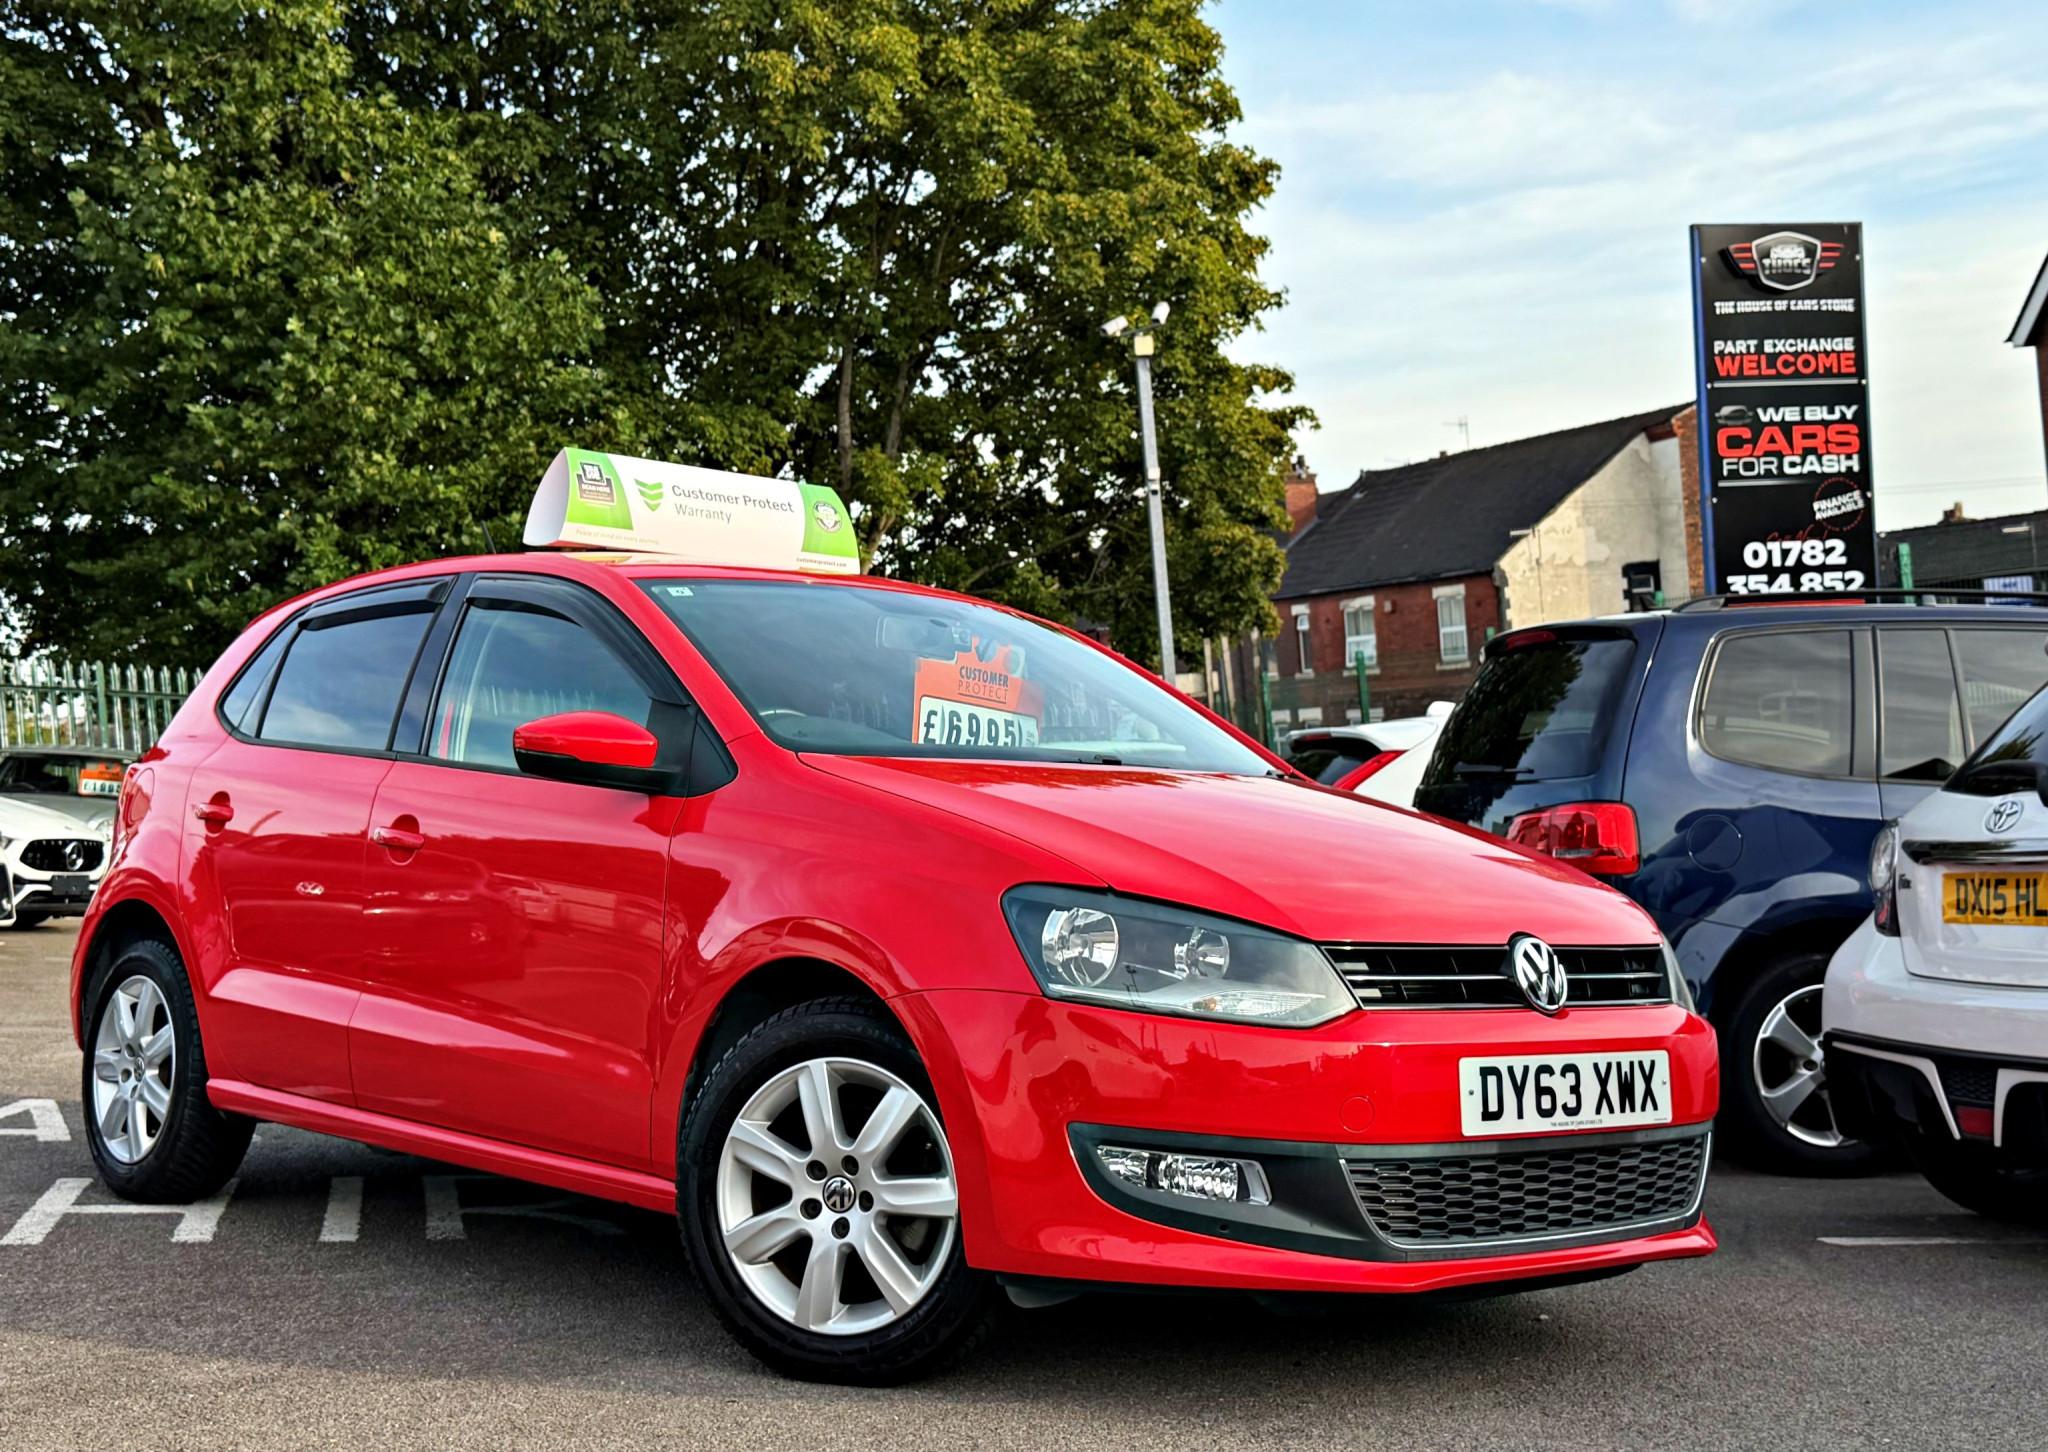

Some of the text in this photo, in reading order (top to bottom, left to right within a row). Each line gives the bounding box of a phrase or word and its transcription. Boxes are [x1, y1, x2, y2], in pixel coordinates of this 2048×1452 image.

[1714, 298, 1855, 315] THE HOUSE OF CARS STORE
[1714, 337, 1855, 354] PART EXCHANGE
[1714, 352, 1857, 376] WELCOME
[1756, 405, 1859, 422] WE BUY
[1717, 424, 1860, 457] CARS
[1722, 454, 1860, 477] FOR CASH
[672, 485, 794, 513] Customer Protect
[1812, 489, 1861, 513] FINANCE
[1815, 499, 1865, 521] AVAILABLE
[674, 503, 732, 524] Warranty
[1743, 538, 1848, 568] 01782
[1726, 573, 1794, 595] 354
[959, 665, 1008, 688] CUSTOMER
[958, 681, 1008, 700] PROTECT
[1955, 878, 2007, 917] DX15
[1479, 1059, 1659, 1122] DY63 XWX
